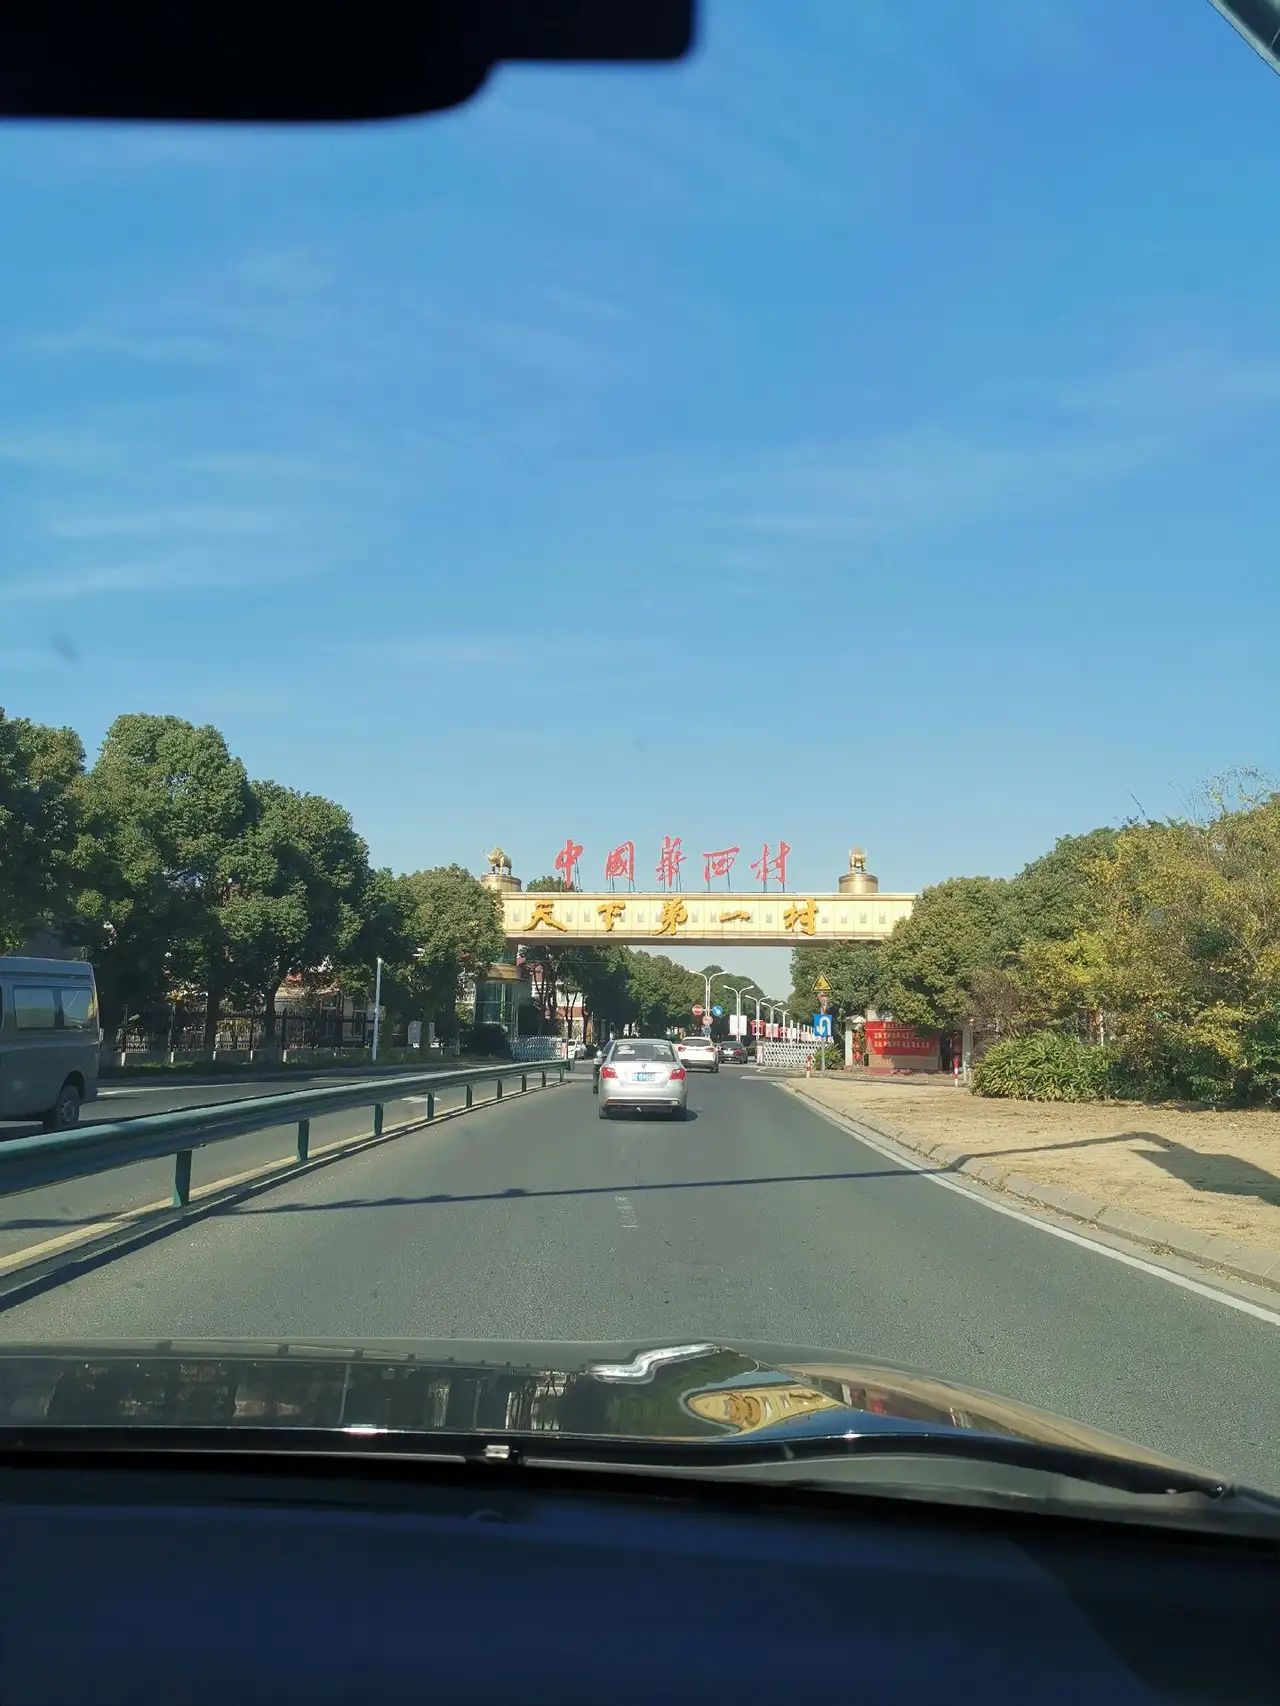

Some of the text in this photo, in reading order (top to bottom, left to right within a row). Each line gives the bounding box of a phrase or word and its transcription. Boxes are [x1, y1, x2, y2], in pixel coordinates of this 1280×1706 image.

[523, 898, 818, 936] 天下第一村
